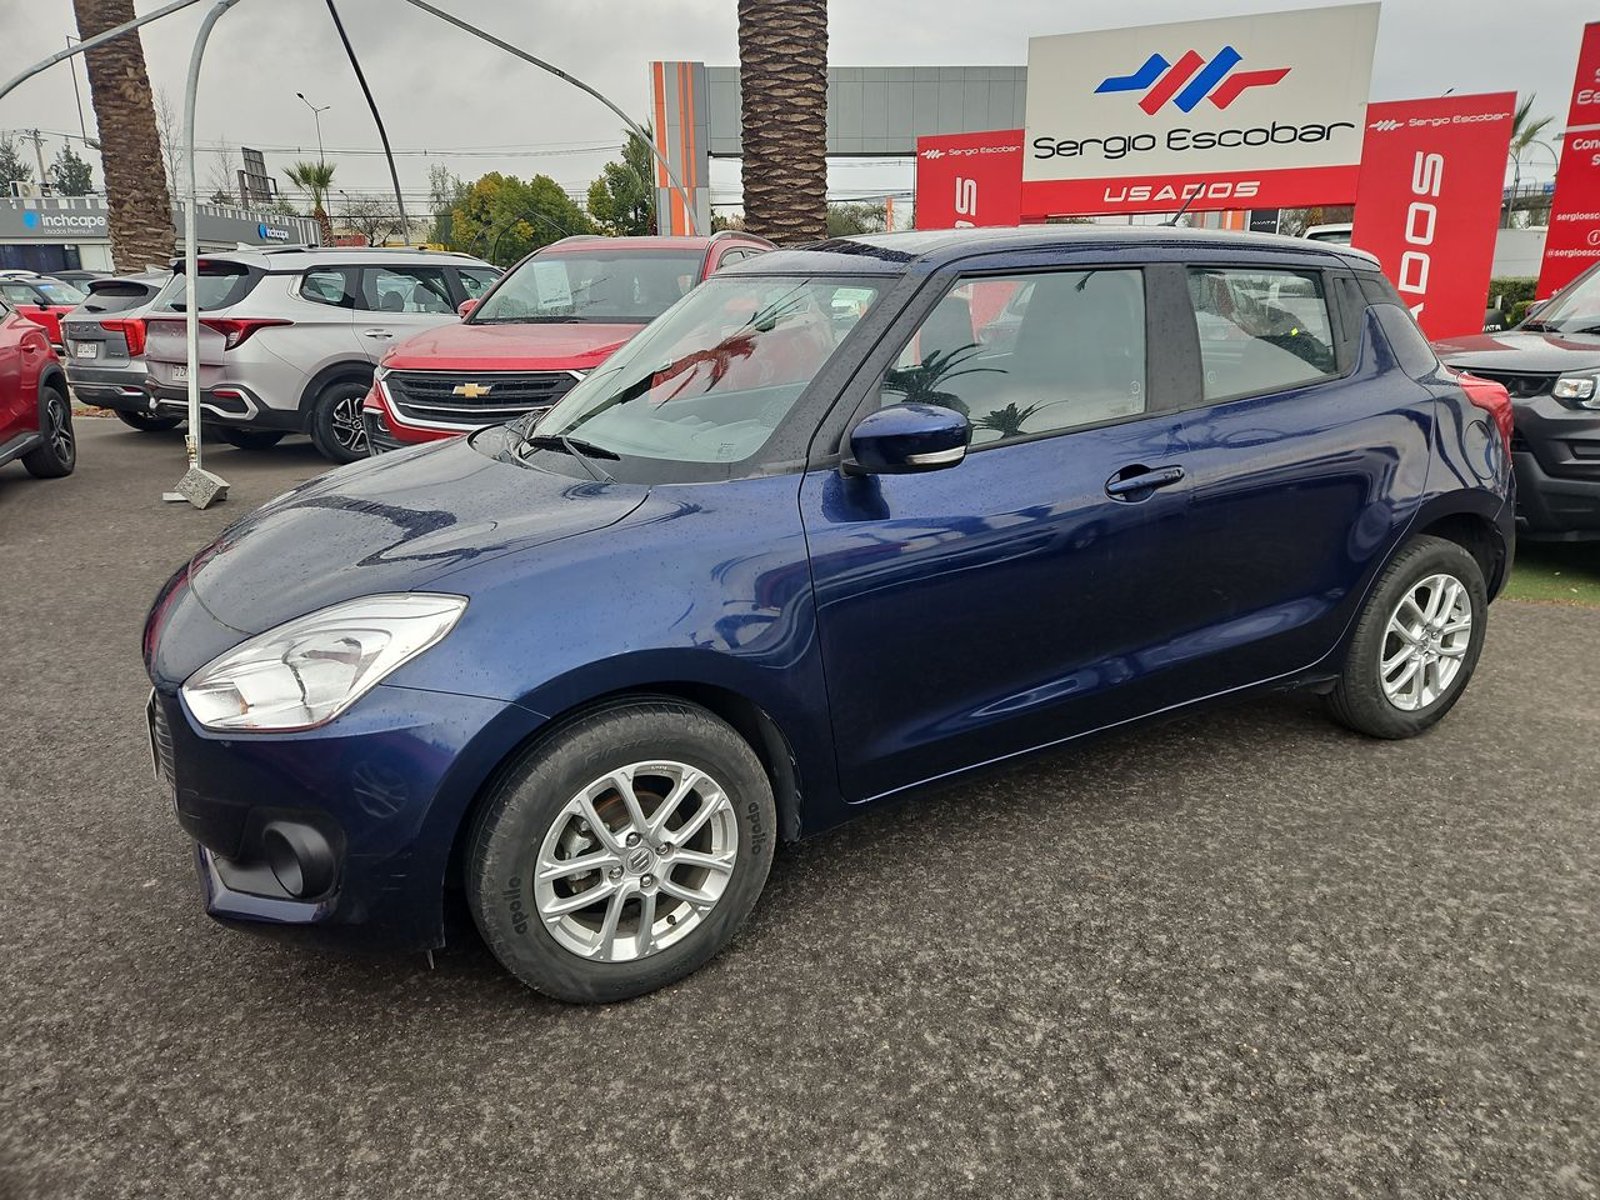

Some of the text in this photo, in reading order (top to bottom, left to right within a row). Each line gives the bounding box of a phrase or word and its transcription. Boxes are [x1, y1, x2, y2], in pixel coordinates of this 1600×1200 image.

[1453, 113, 1510, 123] Escobar
[980, 145, 1020, 153] Escobar
[1033, 121, 1356, 160] Sergio Escobar
[1103, 180, 1262, 203] USADOS
[41, 213, 107, 229] inchcape
[745, 801, 767, 856] apollo
[500, 876, 529, 936] apollo
